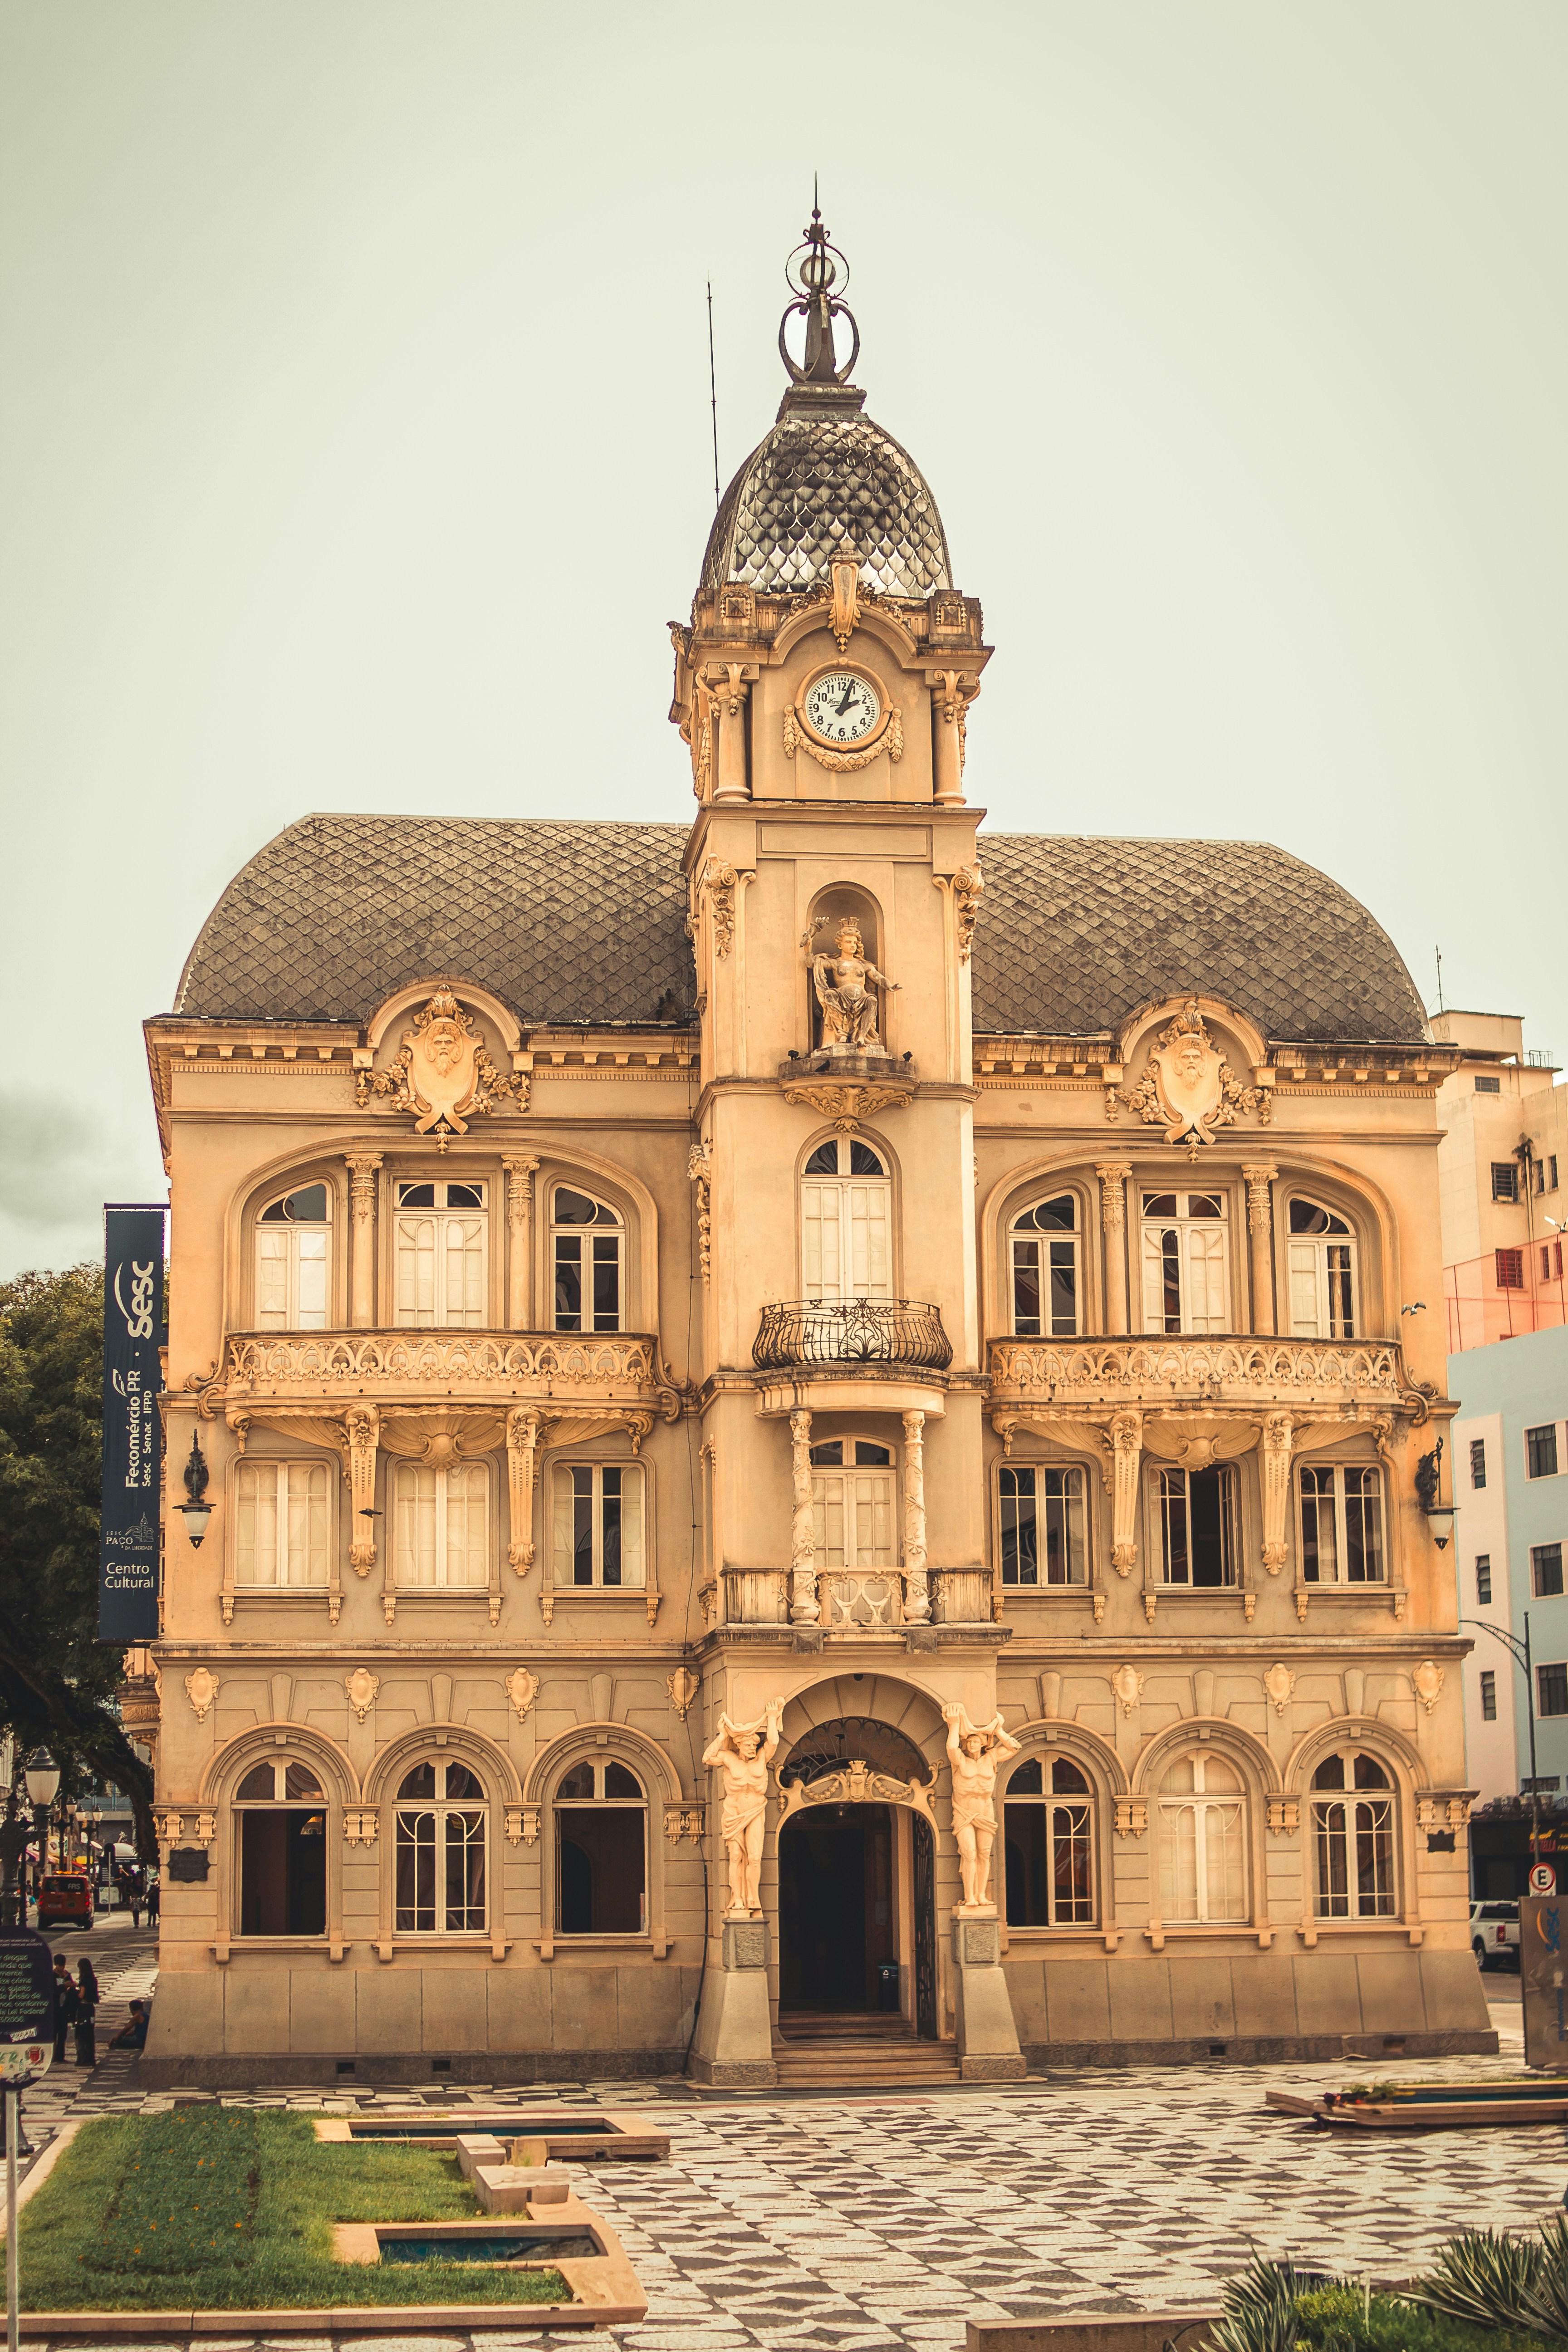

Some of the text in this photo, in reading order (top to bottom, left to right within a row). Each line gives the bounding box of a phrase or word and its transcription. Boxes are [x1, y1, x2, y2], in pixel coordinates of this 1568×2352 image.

[827, 684, 834, 694] 11
[838, 681, 847, 691] 12
[852, 685, 856, 695] 1
[817, 692, 828, 702] 10
[862, 695, 867, 704] 2
[813, 704, 819, 712] 9
[865, 706, 871, 715] 3
[817, 715, 823, 725] 8
[860, 717, 867, 727] 4
[827, 723, 833, 732] 7
[838, 727, 846, 737] 6
[851, 726, 857, 735] 5
[125, 1371, 141, 1488] Fecomércio PR
[142, 1390, 152, 1487] Sesc Senac IFPD
[106, 1537, 133, 1548] PAÇO
[106, 1562, 150, 1574] Centro
[105, 1576, 154, 1588] Cultural
[1538, 1869, 1548, 1886] E
[4, 1954, 28, 1962] drogas
[8, 1985, 32, 1993] sujeito
[9, 1992, 30, 2001] prisão
